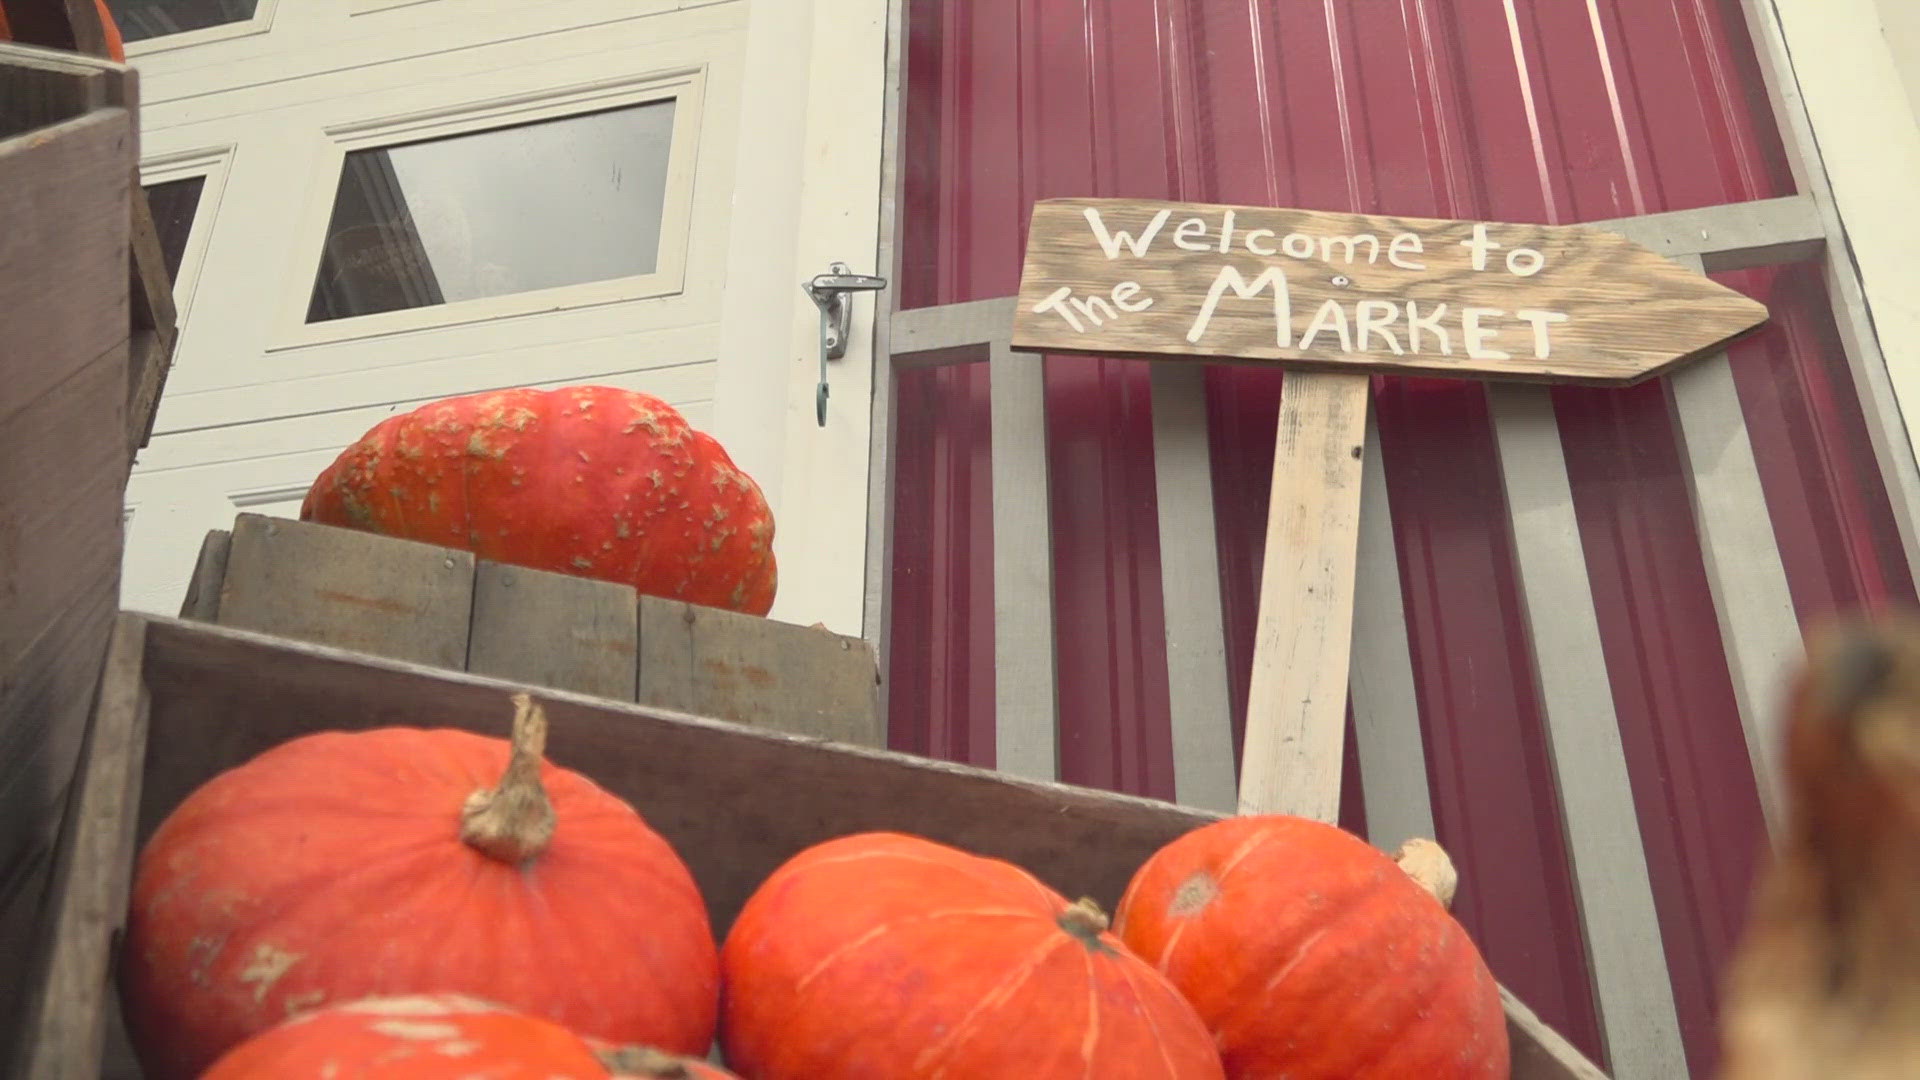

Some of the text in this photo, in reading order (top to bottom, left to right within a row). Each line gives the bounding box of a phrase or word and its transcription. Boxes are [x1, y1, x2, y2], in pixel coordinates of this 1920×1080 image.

[1084, 207, 1544, 276] Welcome to
[1032, 265, 1570, 360] The MARKET
